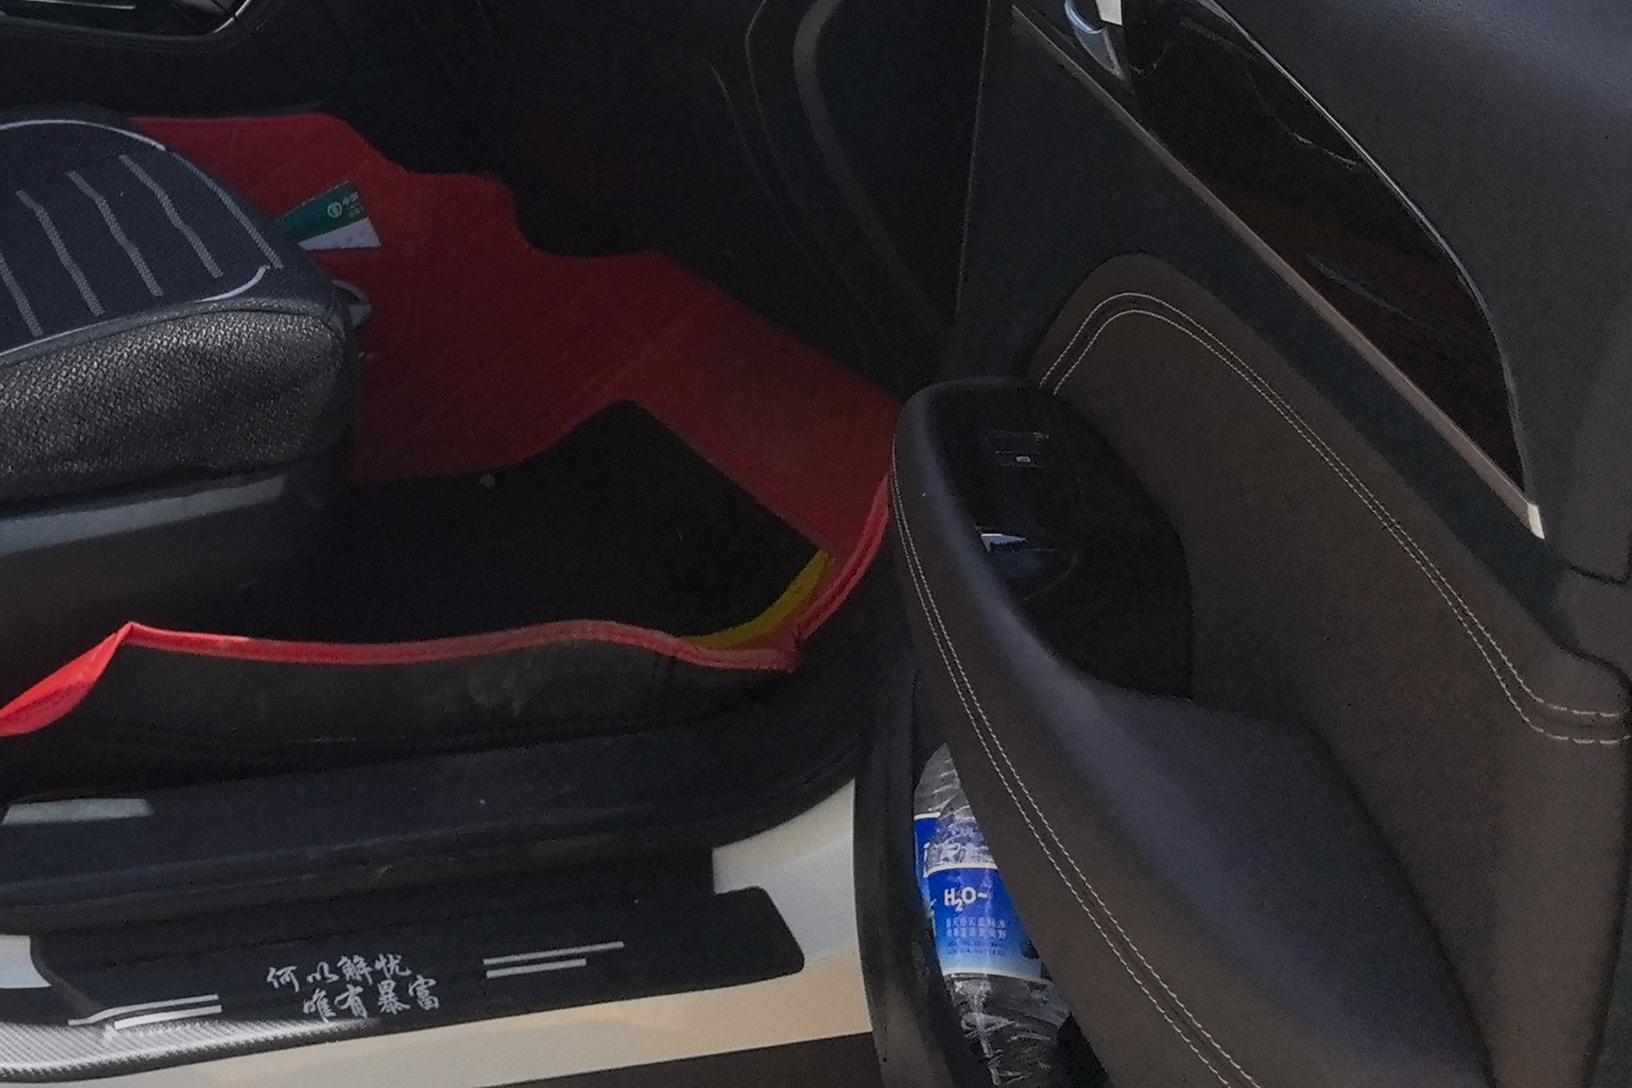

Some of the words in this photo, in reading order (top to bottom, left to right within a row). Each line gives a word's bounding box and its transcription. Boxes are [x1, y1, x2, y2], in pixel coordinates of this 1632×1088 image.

[266, 953, 412, 993] 何以解忧
[302, 975, 440, 1024] 唯有暴富
